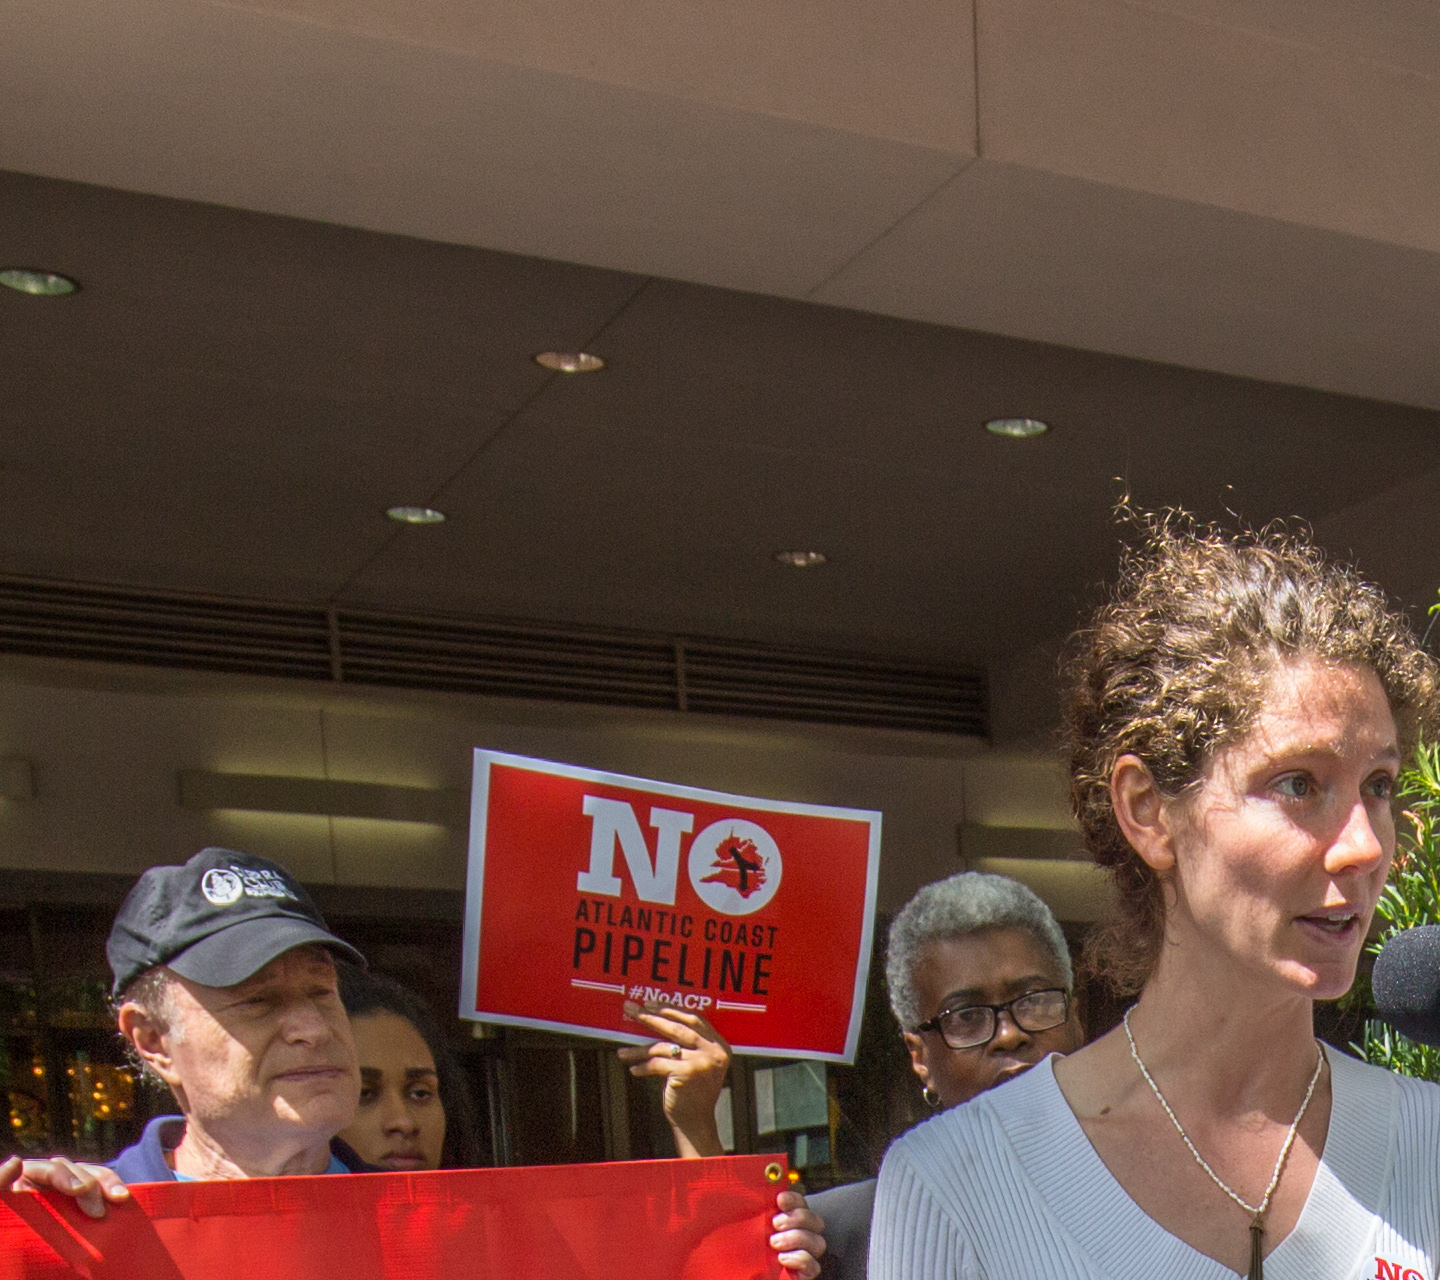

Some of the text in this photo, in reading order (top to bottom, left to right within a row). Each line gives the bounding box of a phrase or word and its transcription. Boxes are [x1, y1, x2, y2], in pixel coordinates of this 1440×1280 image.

[576, 794, 783, 916] NO
[575, 899, 779, 950] ATLANTIC COAST
[572, 927, 774, 997] PIPELINE
[628, 984, 712, 1011] #NoACP
